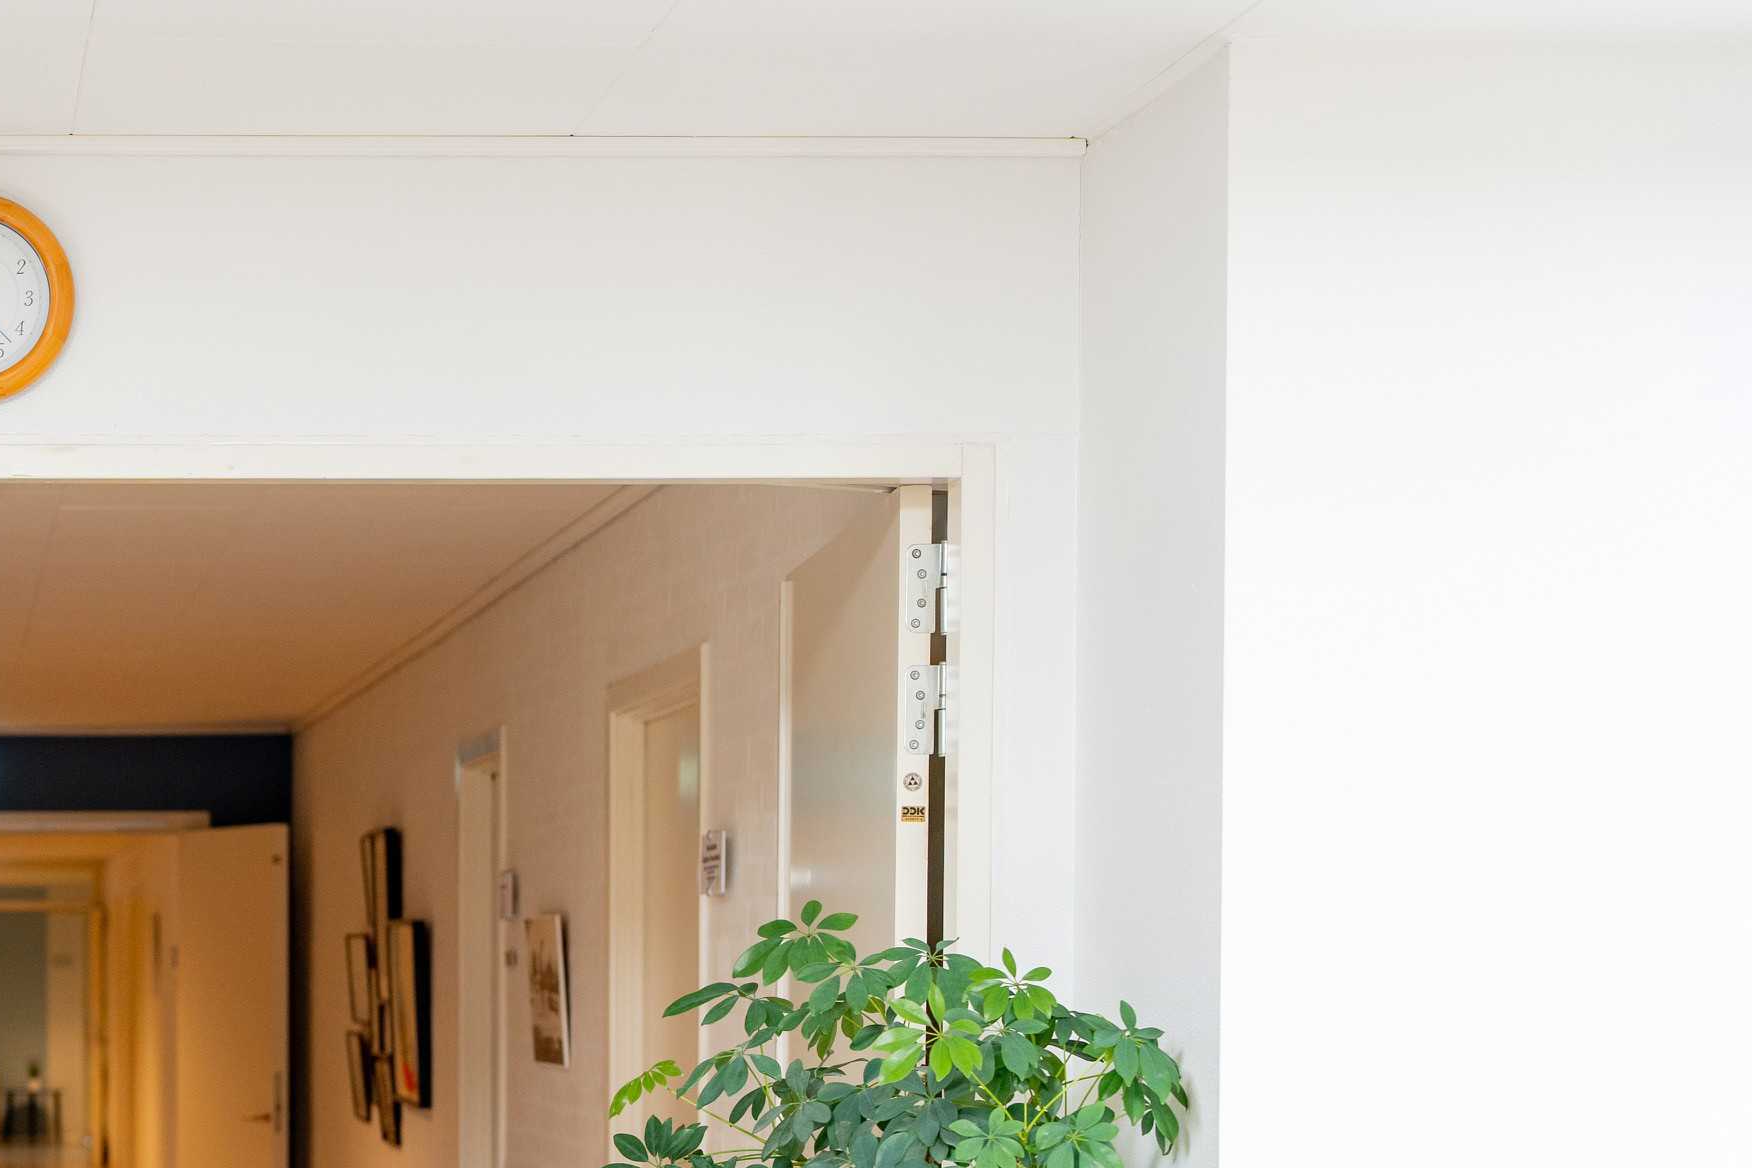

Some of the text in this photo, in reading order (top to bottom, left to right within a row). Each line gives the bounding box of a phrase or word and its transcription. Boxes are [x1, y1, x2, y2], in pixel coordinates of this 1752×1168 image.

[17, 259, 26, 275] 2
[23, 290, 34, 307] 3
[15, 320, 25, 336] 4
